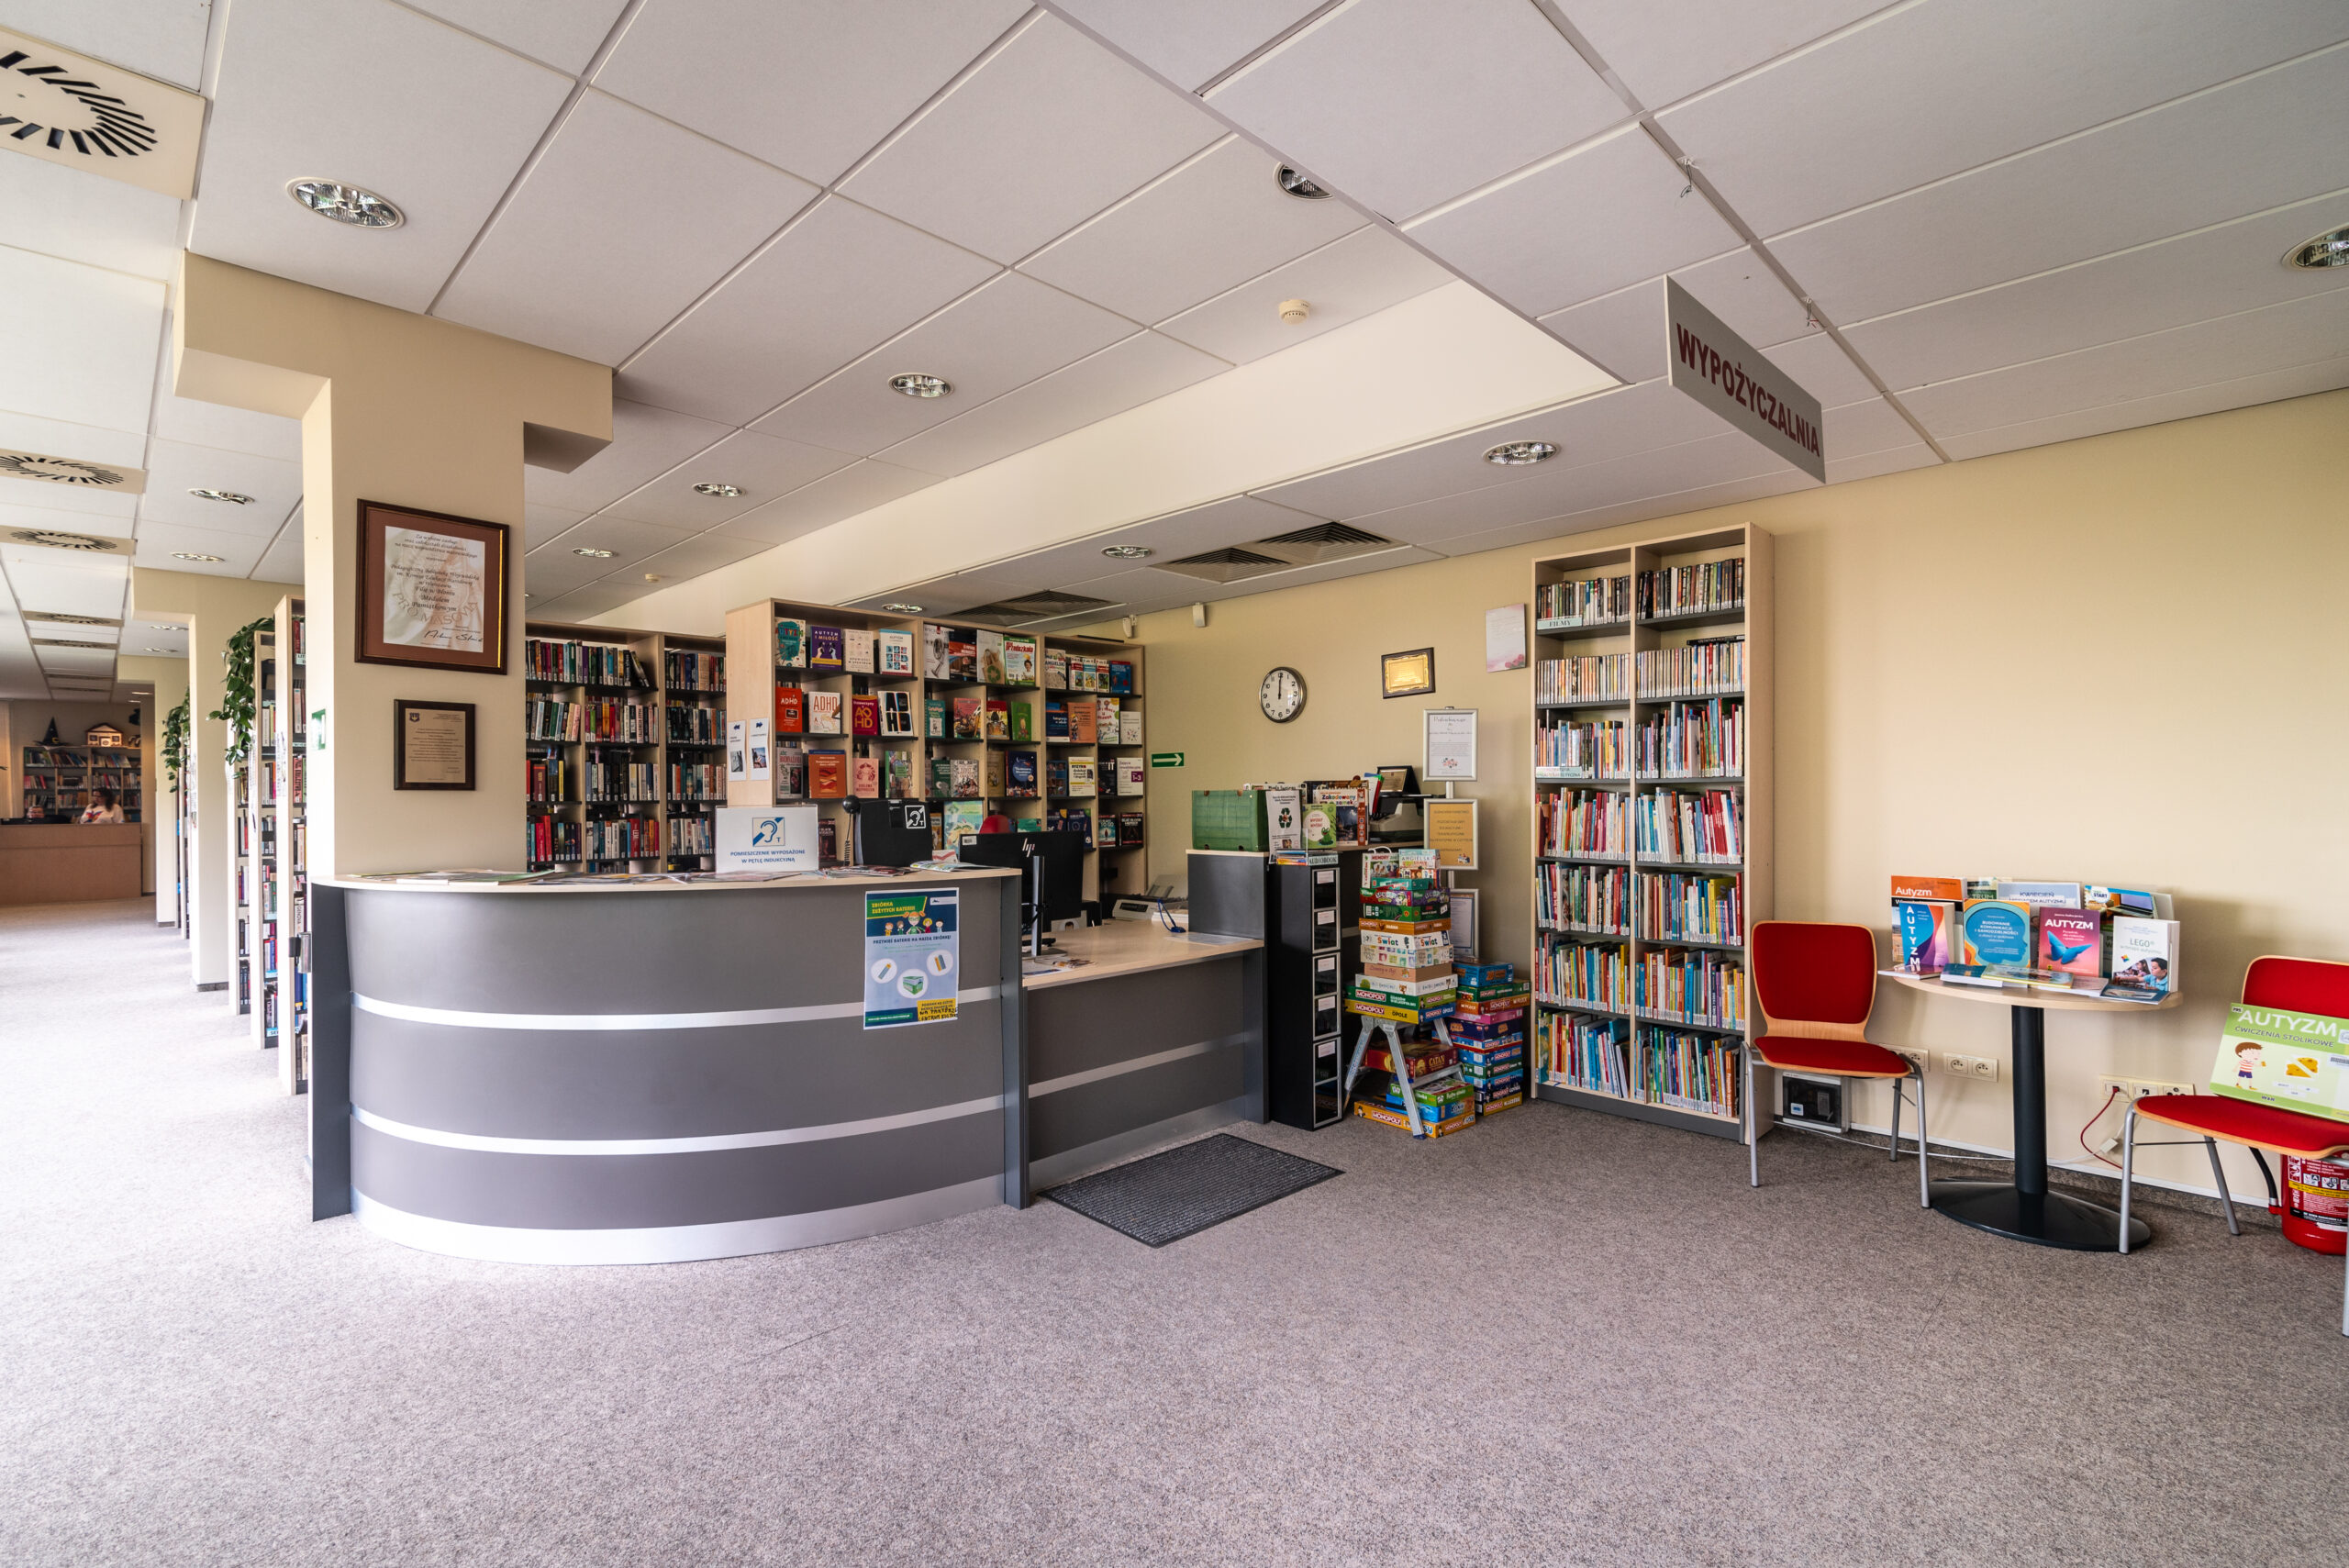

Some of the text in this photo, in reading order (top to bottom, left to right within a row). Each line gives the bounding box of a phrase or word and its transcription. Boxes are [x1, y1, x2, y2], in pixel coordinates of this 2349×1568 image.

[1676, 322, 1820, 458] WYPOŻYCZALNIA
[780, 697, 798, 706] ADHD
[813, 695, 838, 713] ADHD
[1895, 886, 1932, 898] Autyzm
[2044, 918, 2094, 930] AUTYZM
[1906, 906, 1920, 965] AUTYZM
[1355, 989, 1386, 1002] MONOPOLY
[1355, 1003, 1408, 1018] MONOPOLY OPOLE
[1489, 999, 1510, 1010] MONOPOLY
[1425, 1009, 1442, 1018] MONOPOLY
[2237, 1010, 2337, 1038] AUTYZM
[2282, 1033, 2334, 1048] STOLIKOWE
[1429, 1054, 1445, 1066] CATAN
[1495, 1051, 1510, 1061] MONOPOLY
[1493, 1063, 1509, 1073] MONOPOLY
[1495, 1075, 1510, 1084] MONOPOLY
[1493, 1087, 1509, 1098] MONOPOLY
[1486, 1102, 1502, 1111] MONOPOLY
[1372, 1111, 1402, 1125] MONOPOLY
[1444, 1121, 1462, 1130] MONOPOLY
